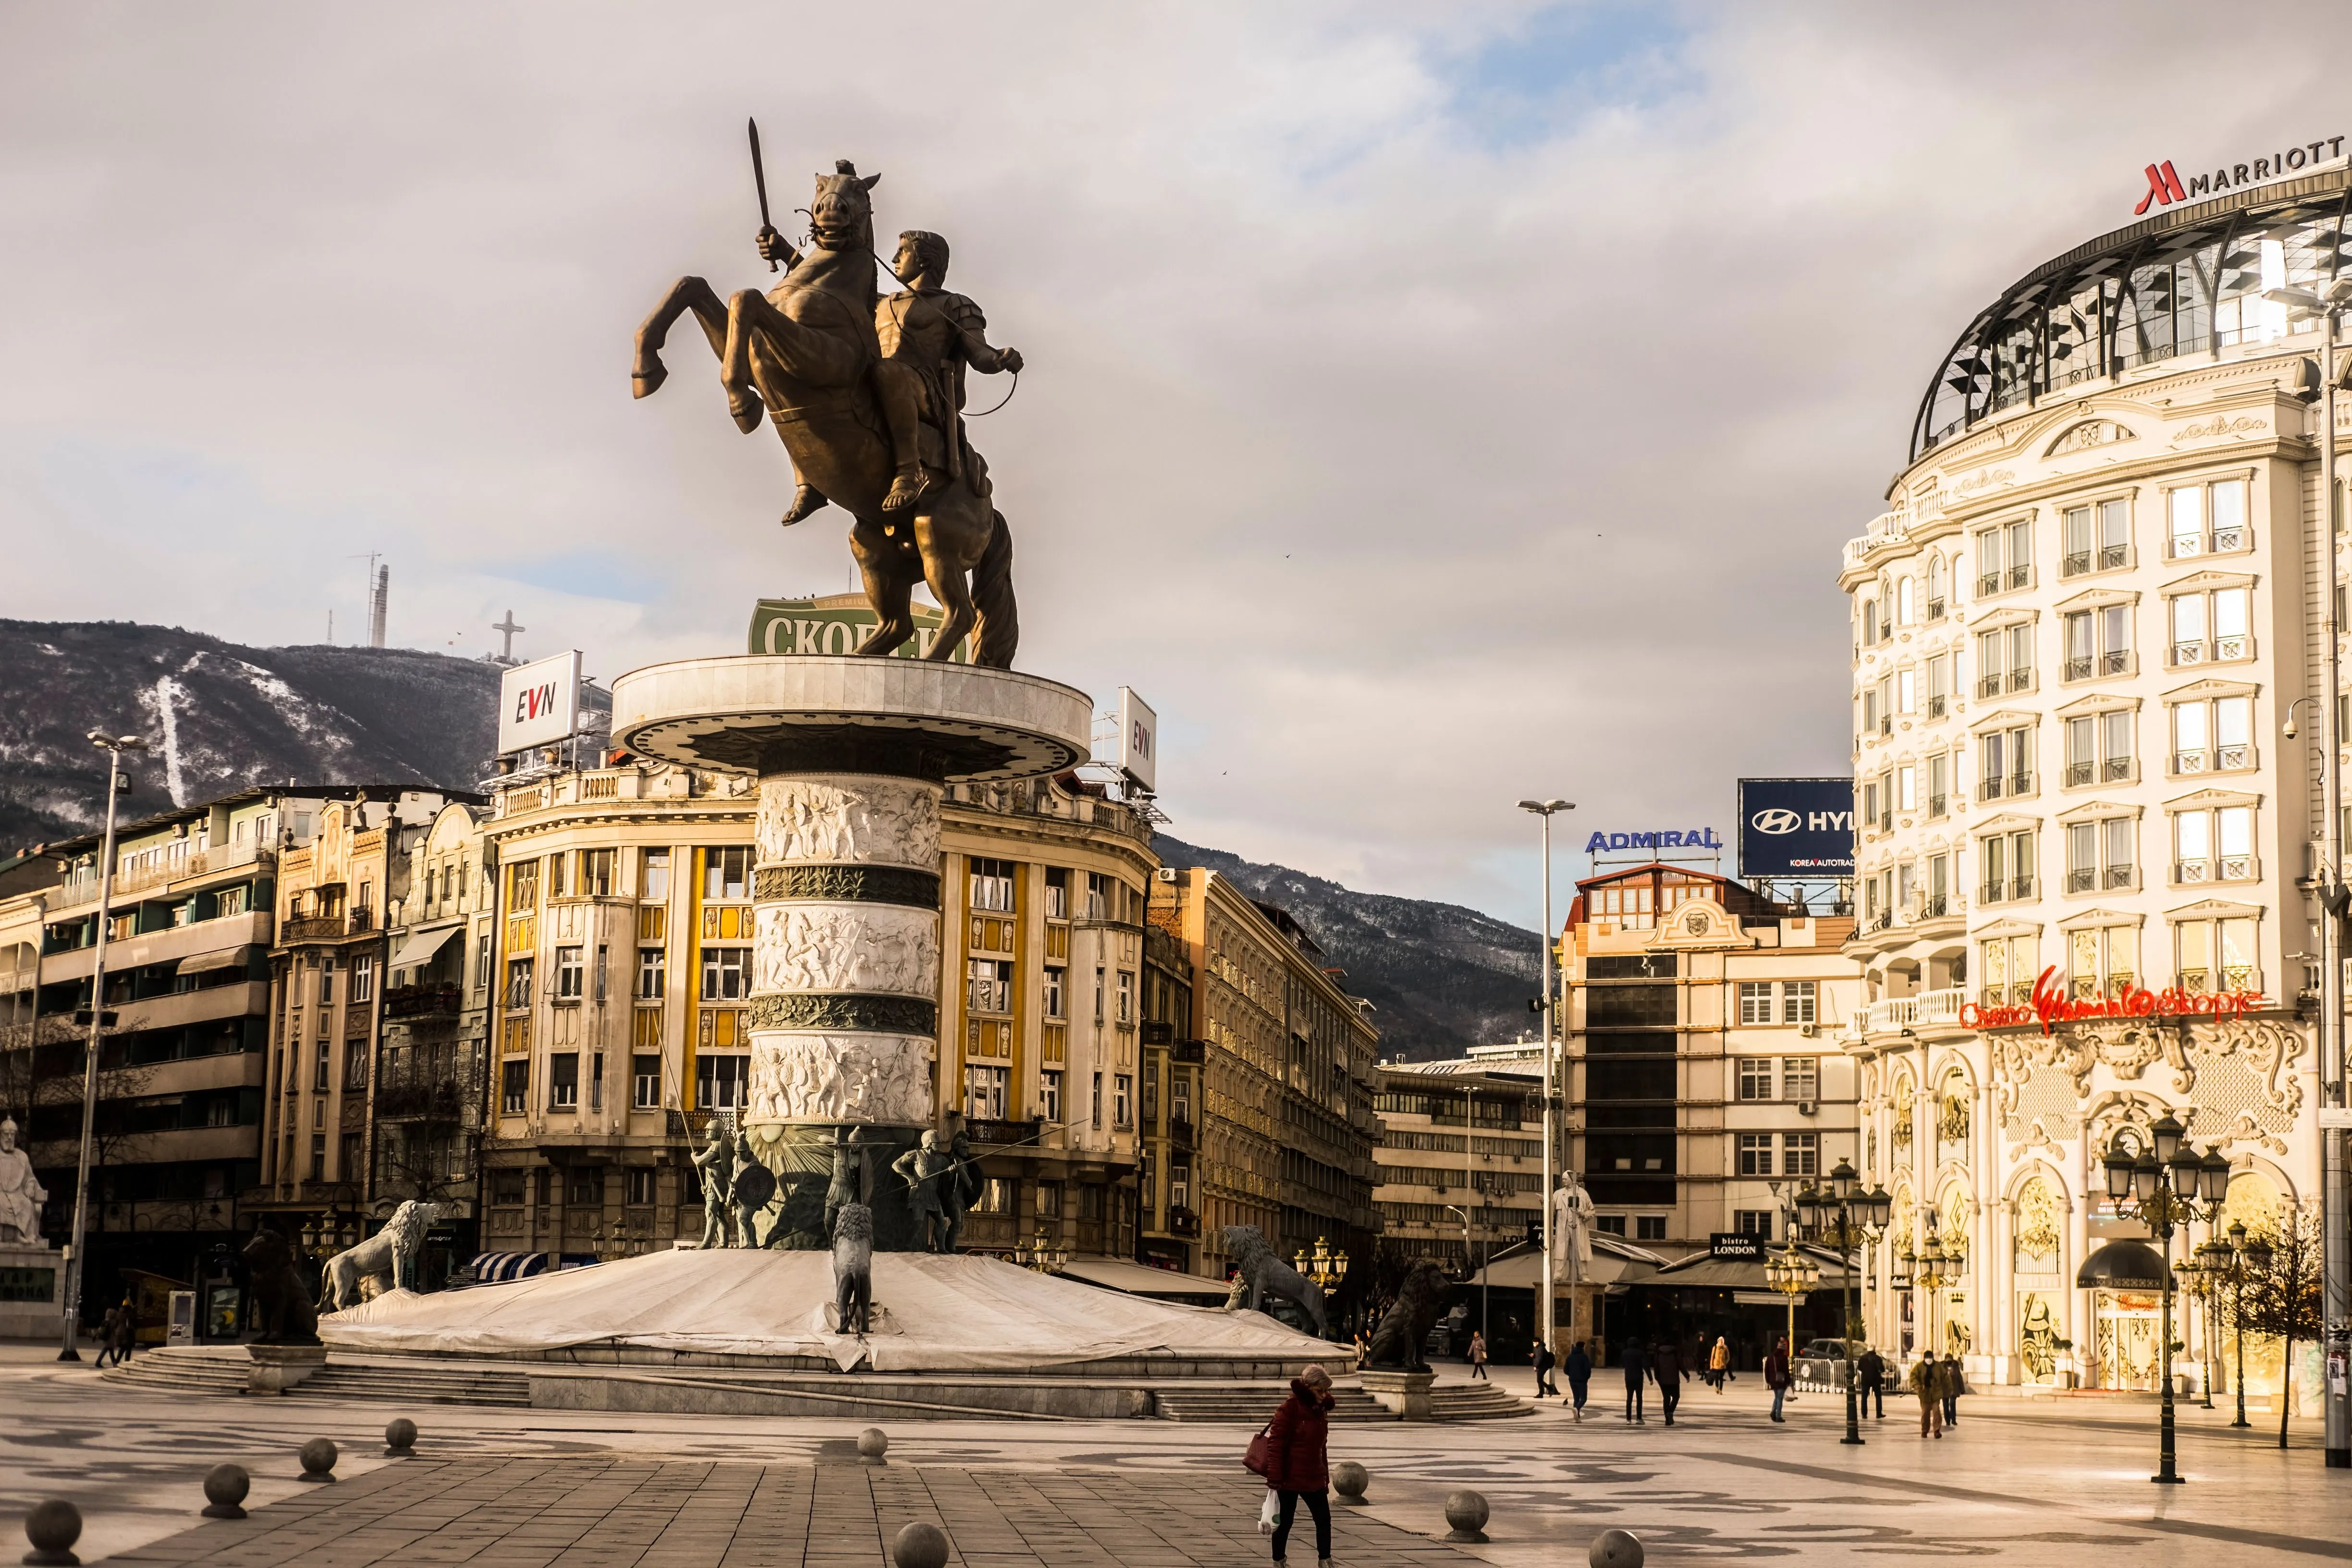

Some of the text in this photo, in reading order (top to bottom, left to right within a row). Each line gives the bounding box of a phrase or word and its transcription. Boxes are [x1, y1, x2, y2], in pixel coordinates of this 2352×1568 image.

[2190, 136, 2345, 198] MARRIOTT
[515, 682, 556, 723] EVN
[1133, 719, 1150, 760] EVN
[1585, 827, 1723, 853] ADMIRAL
[1959, 1001, 2032, 1029] Casino
[2157, 986, 2264, 1023] Skopje
[1714, 1246, 1757, 1255] LONDON
